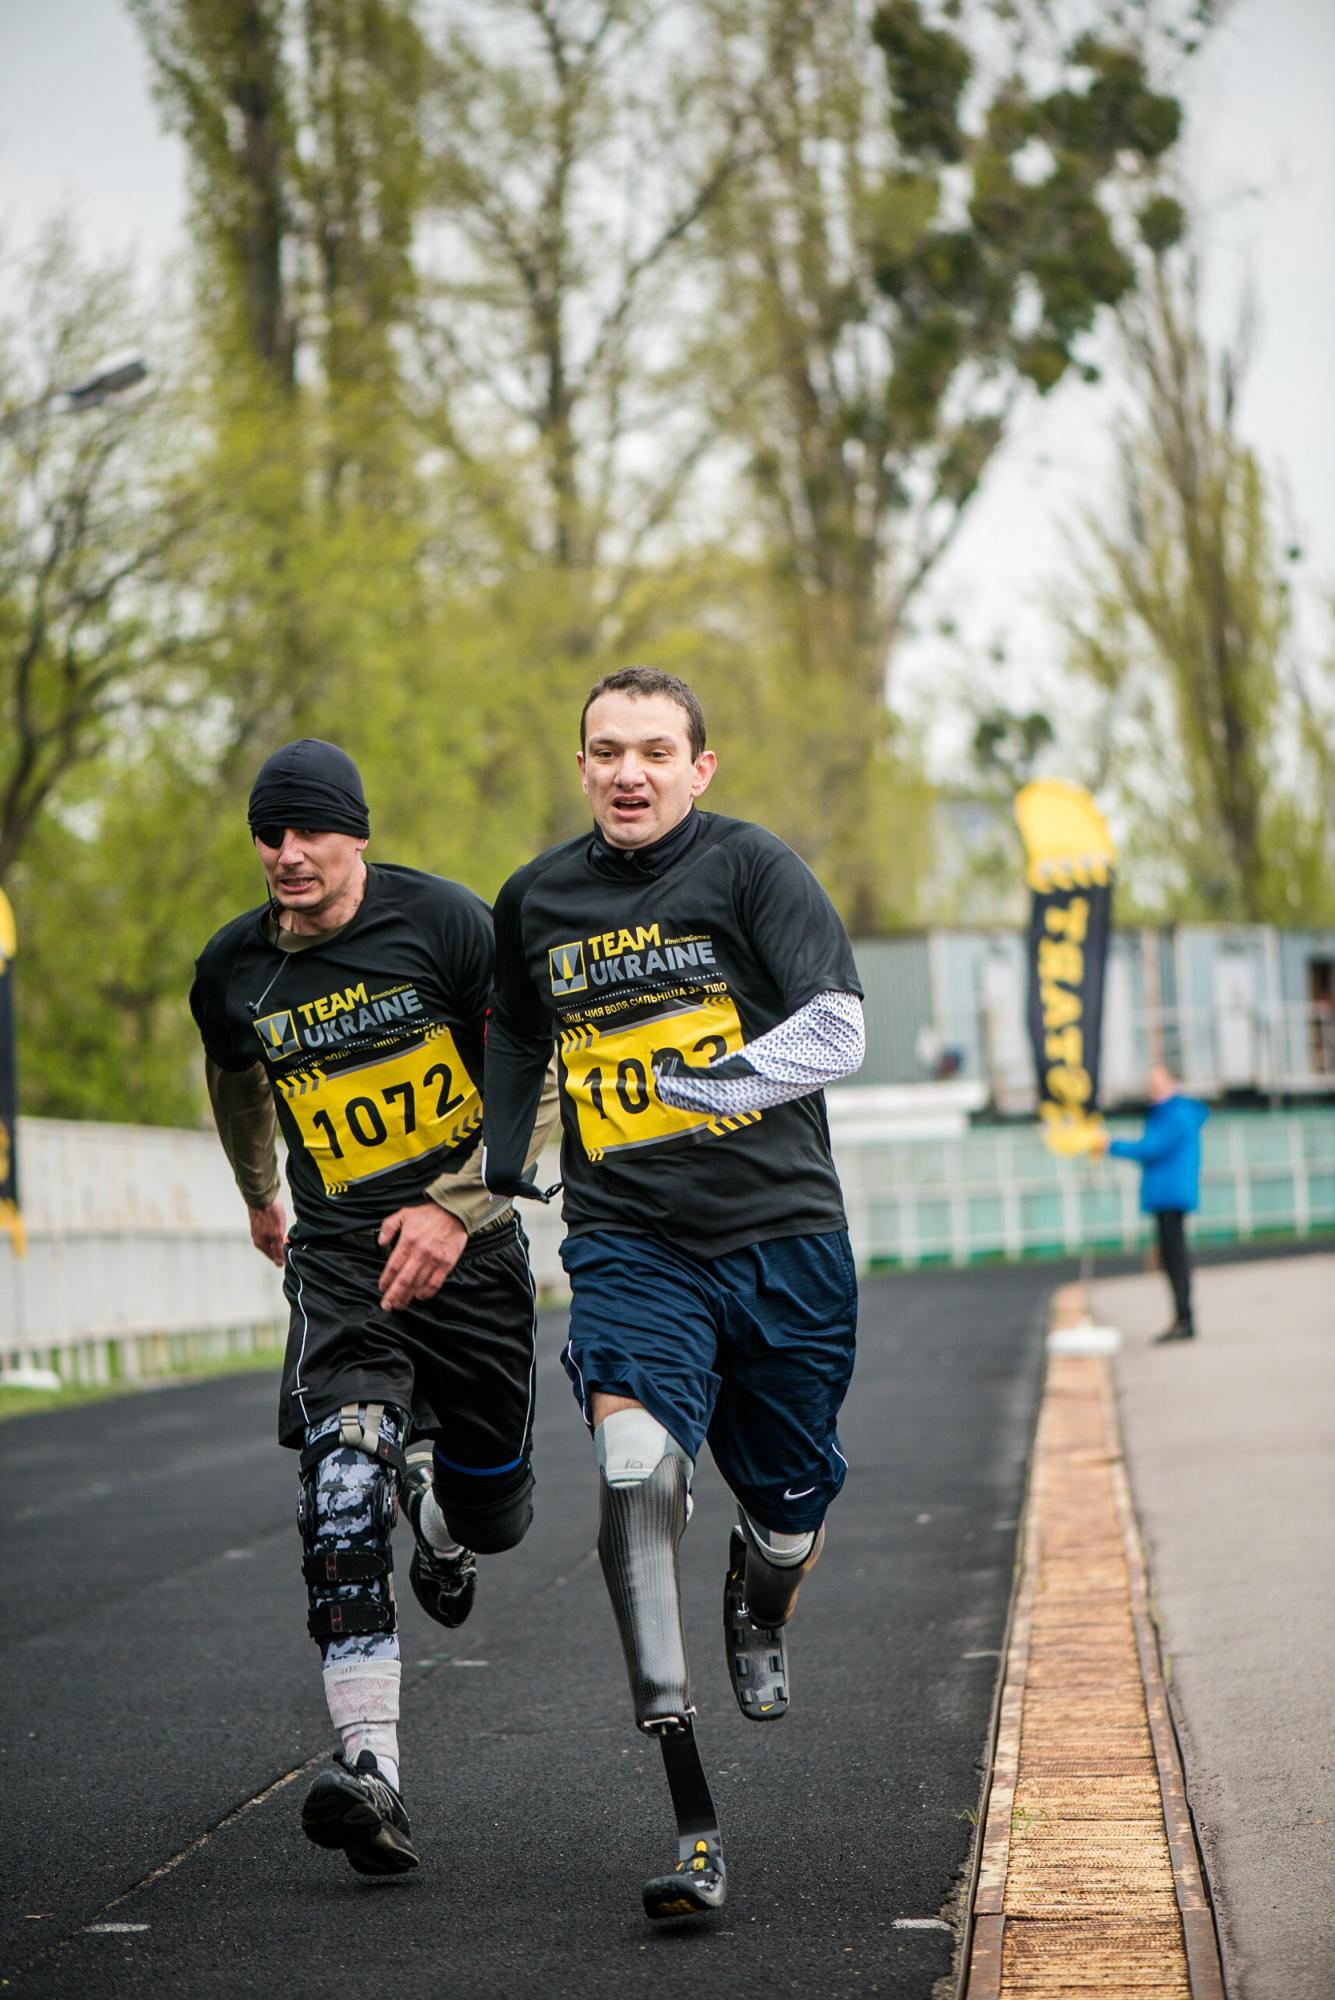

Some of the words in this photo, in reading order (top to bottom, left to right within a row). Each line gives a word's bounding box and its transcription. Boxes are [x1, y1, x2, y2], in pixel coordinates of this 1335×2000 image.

[588, 923, 661, 961] TEAM
[590, 941, 716, 986] UKRAINE
[297, 982, 369, 1025] TEAM
[303, 989, 424, 1048] UKRAINE
[585, 1003, 604, 1019] ЧИЯ
[605, 999, 629, 1016] ВОЛЯ
[630, 986, 687, 1007] СИЛЬНІША
[703, 981, 728, 994] ТІЛО
[583, 1034, 728, 1120] 103
[312, 1062, 465, 1159] 1072
